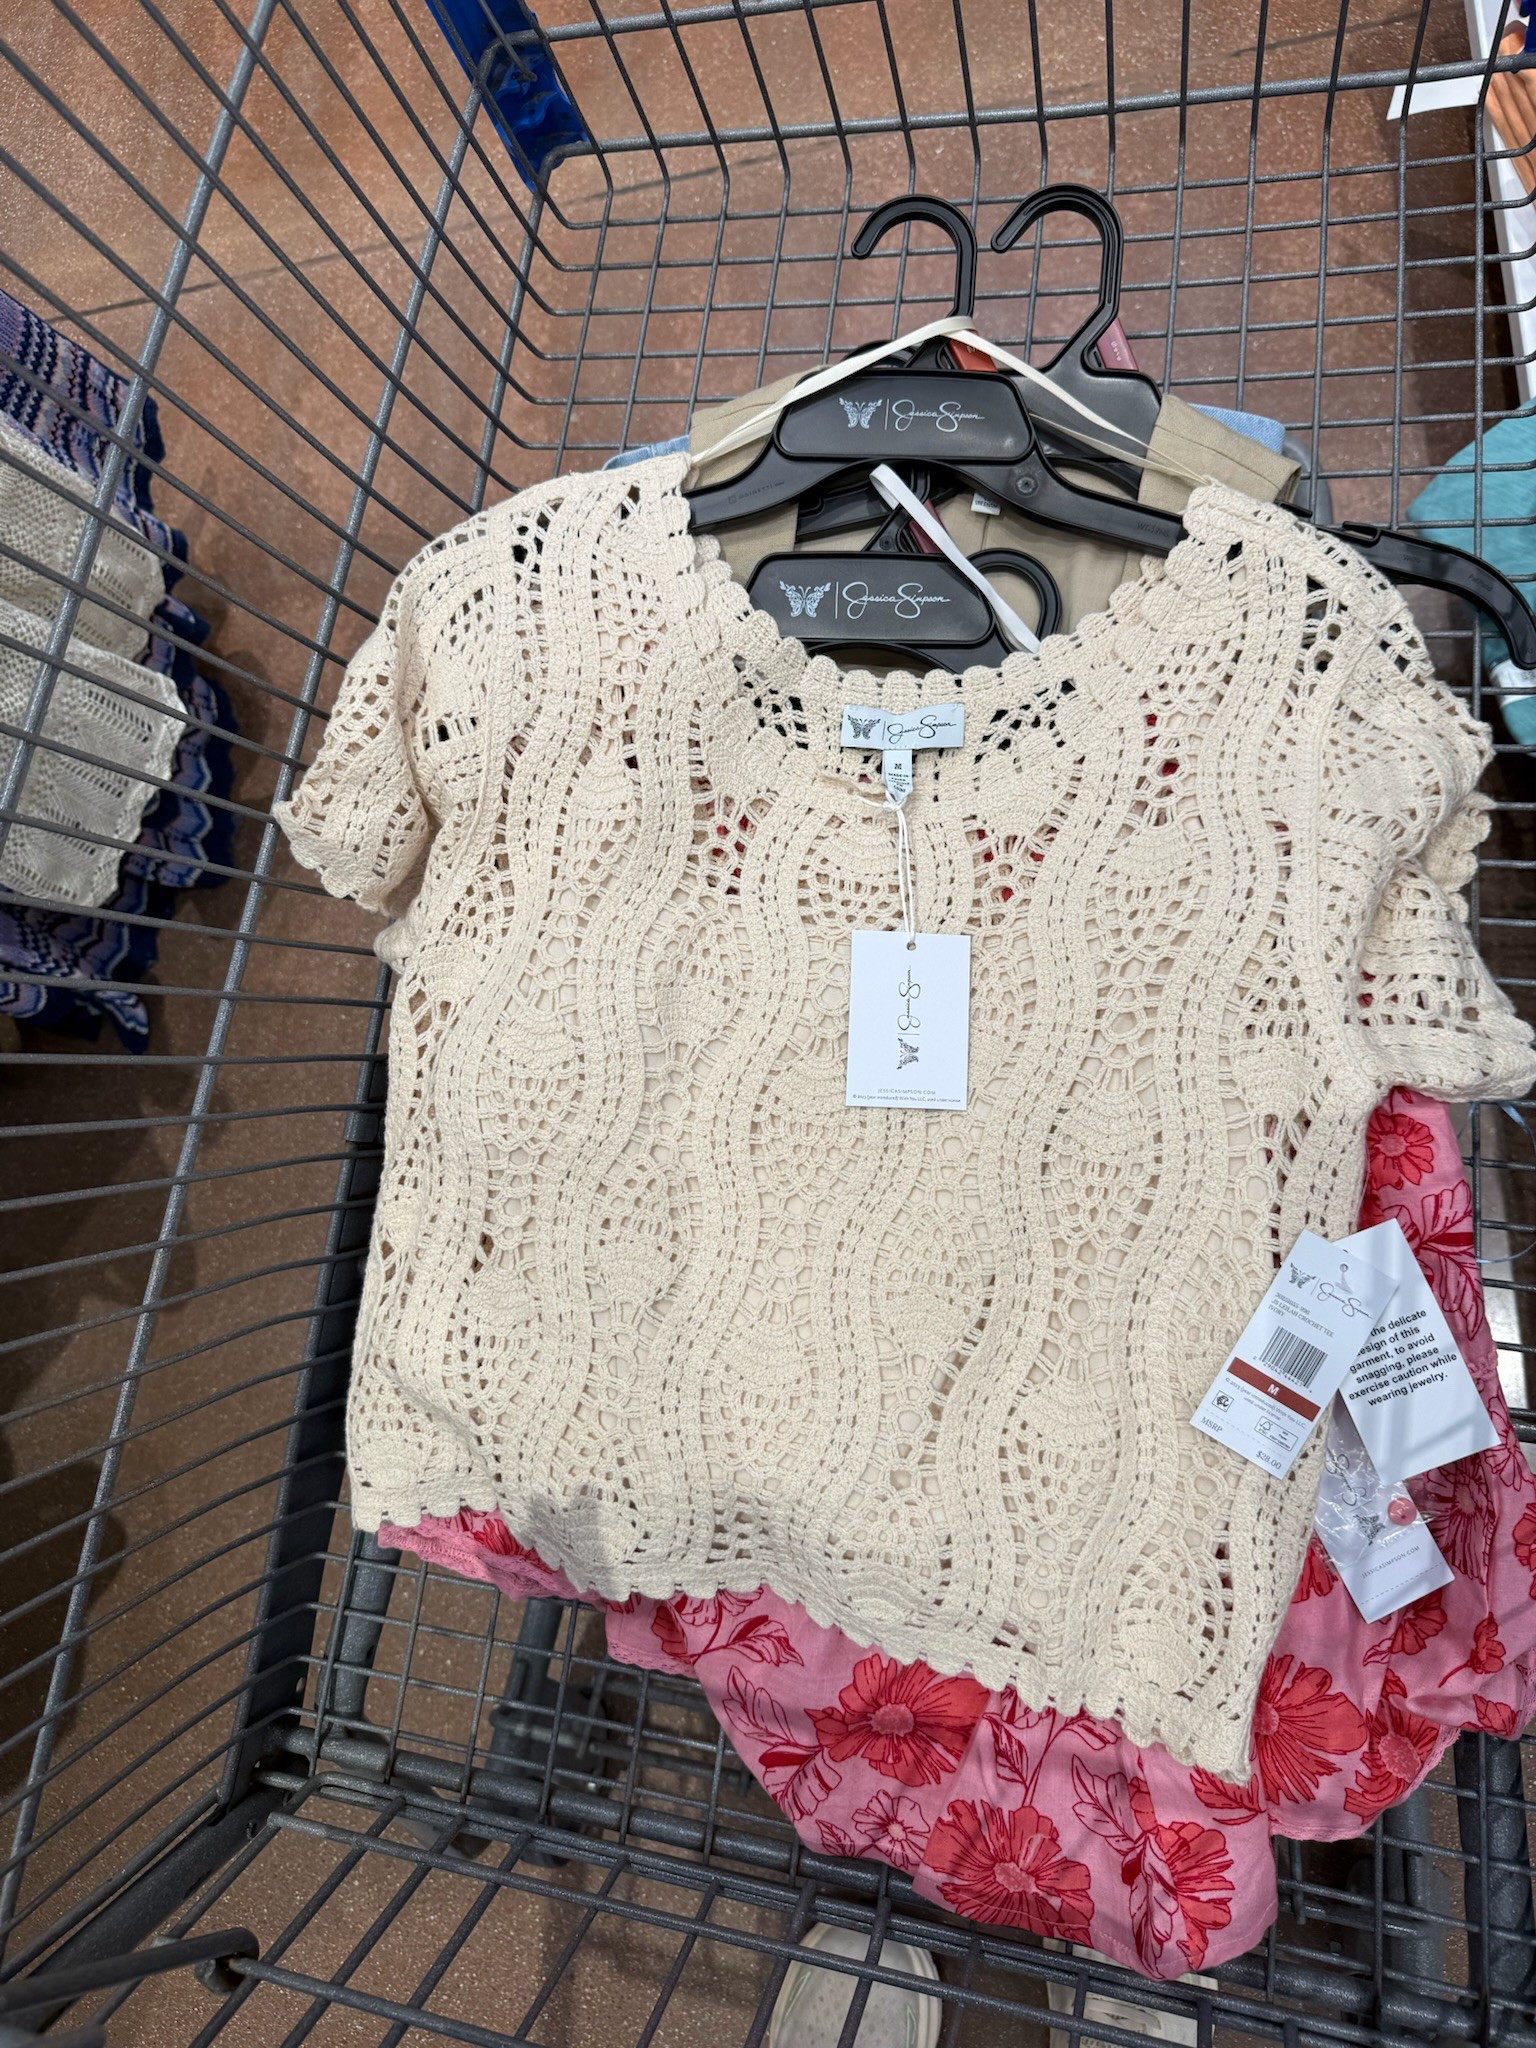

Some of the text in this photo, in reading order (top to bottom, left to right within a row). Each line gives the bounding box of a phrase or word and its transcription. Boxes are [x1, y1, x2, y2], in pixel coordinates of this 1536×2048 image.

[892, 400, 985, 432] Jessica Simpson
[842, 581, 951, 619] Jessica Simpson
[887, 723, 921, 744] Jessica
[1317, 1282, 1345, 1301] Jessica
[1388, 1309, 1427, 1330] delicate
[1388, 1333, 1400, 1343] of
[1400, 1326, 1420, 1339] this
[1349, 1333, 1435, 1374] garment, to avoid
[1356, 1346, 1439, 1384] snagging, please
[1348, 1353, 1457, 1400] exercise caution while
[1267, 1384, 1279, 1395] M
[1367, 1372, 1448, 1406] wearing jewelry.
[1201, 1416, 1223, 1433] MSRP
[1255, 1450, 1282, 1470] $28.00
